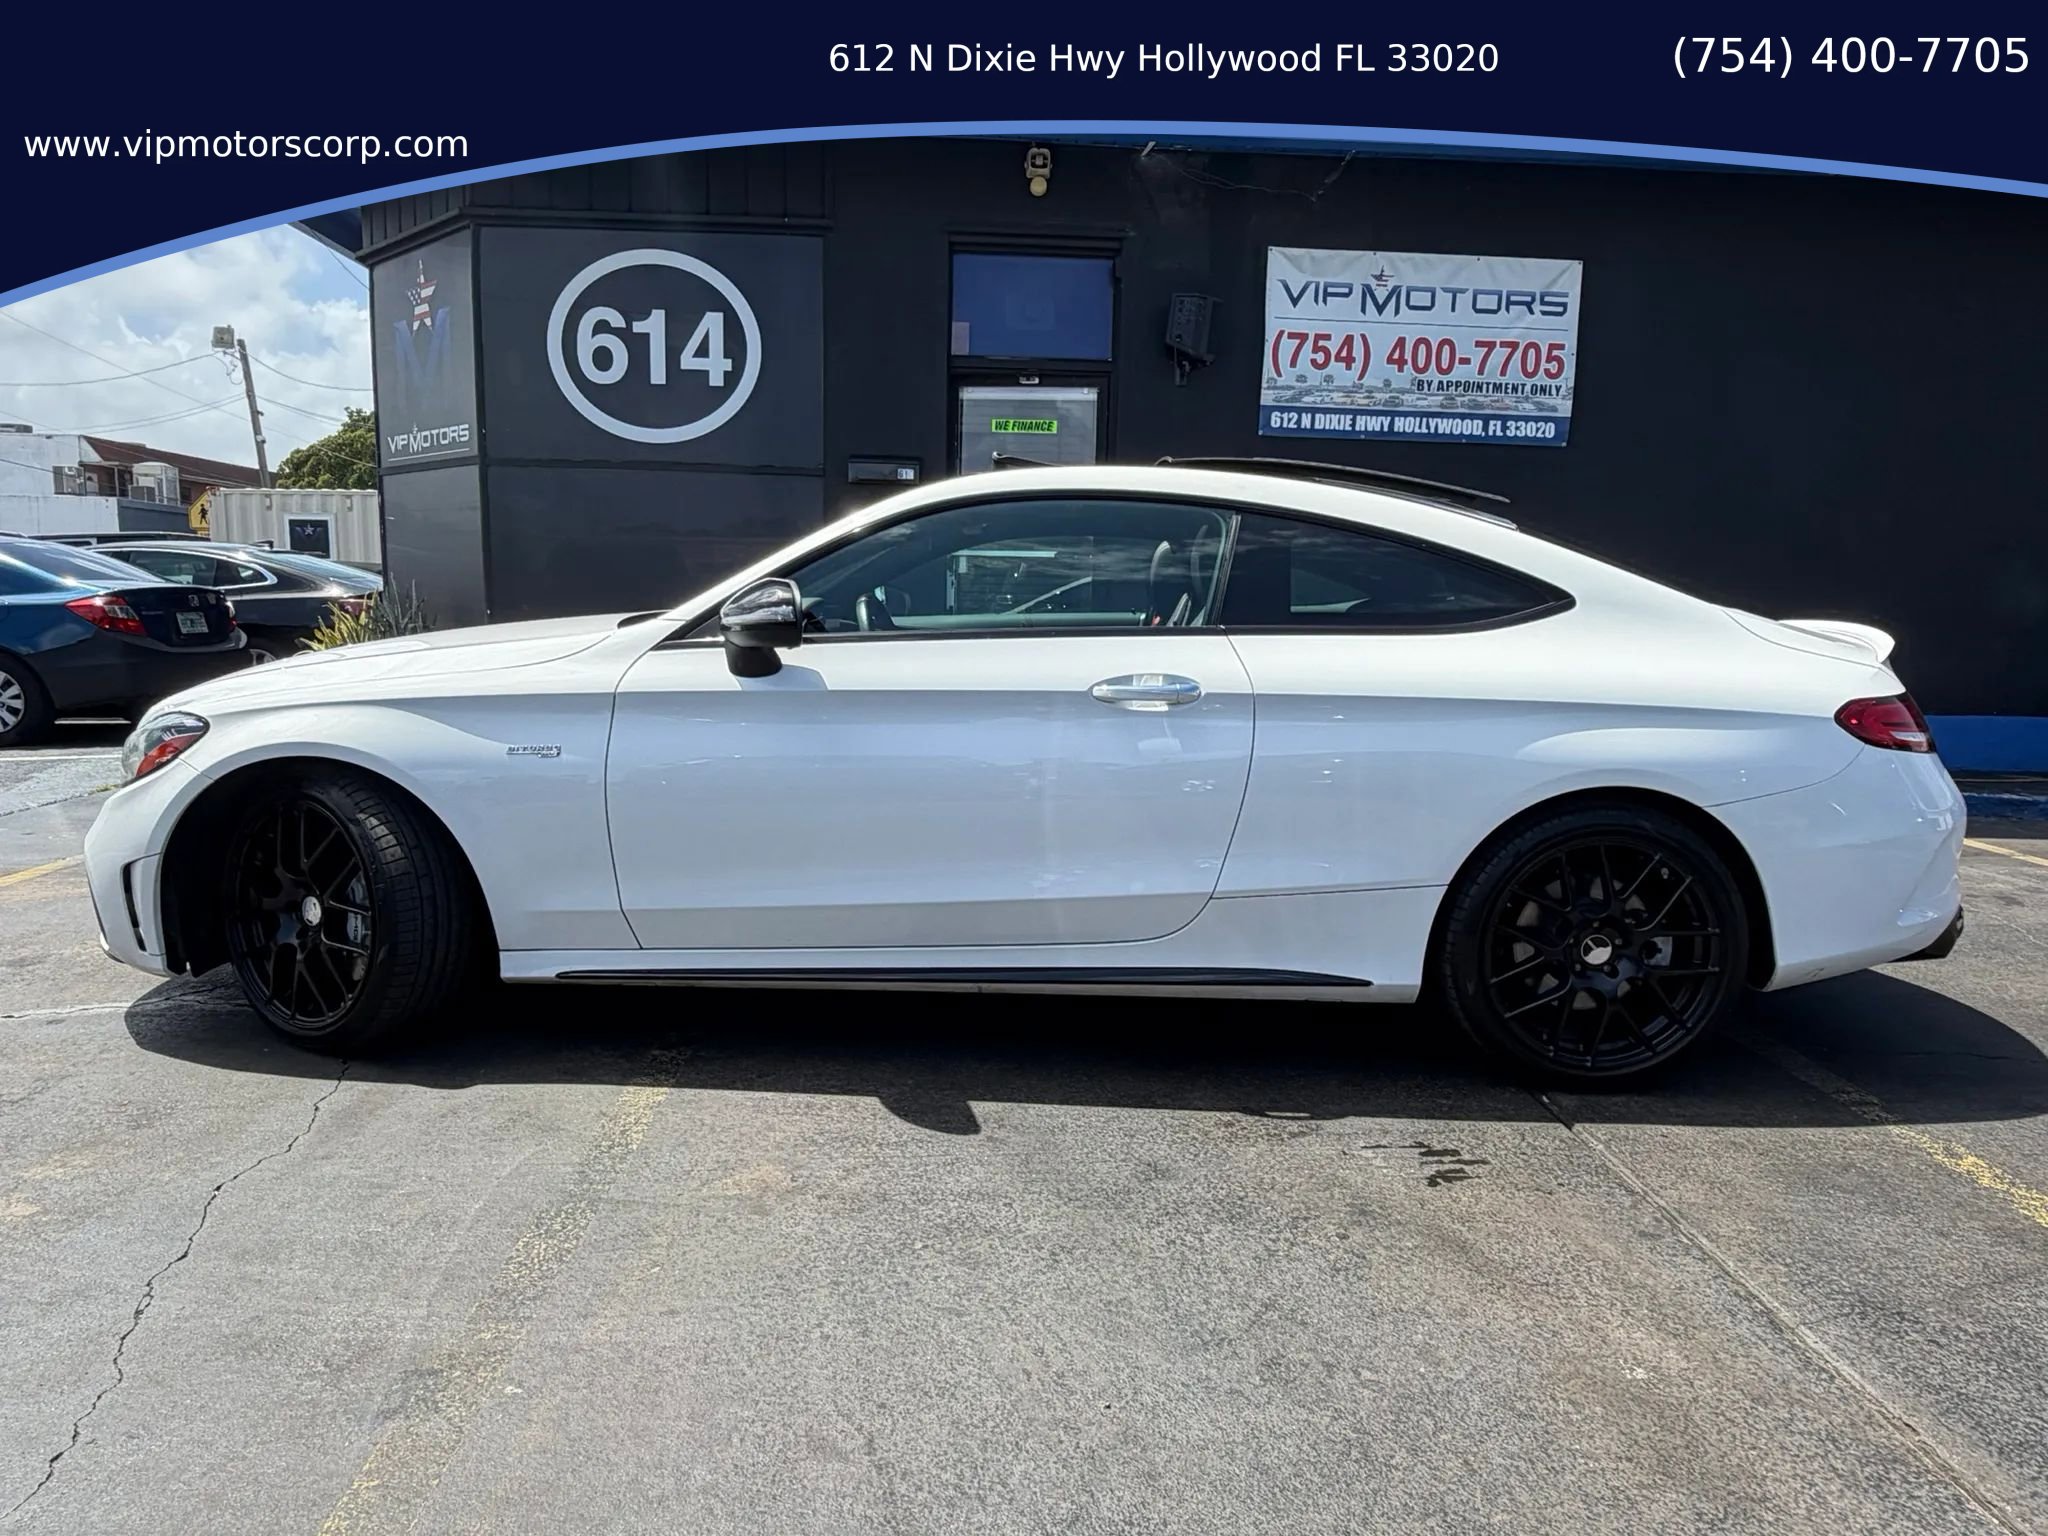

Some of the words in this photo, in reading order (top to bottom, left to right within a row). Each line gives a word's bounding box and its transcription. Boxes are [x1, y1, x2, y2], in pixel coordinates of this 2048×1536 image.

[1277, 279, 1354, 308] VIP
[1360, 283, 1569, 318] MOTORS
[577, 306, 733, 387] 614
[1271, 329, 1371, 381] (754)
[1385, 335, 1566, 380] 400-7705
[1416, 379, 1434, 393] BY
[1436, 380, 1527, 396] APPOINTMENT
[1529, 382, 1563, 397] ONLY
[387, 434, 408, 454] VIP
[409, 424, 470, 453] MOTORS
[995, 420, 1010, 431] WE
[1011, 420, 1054, 432] FINANCE
[1270, 411, 1298, 428] 612
[1300, 412, 1312, 429] N
[1314, 413, 1353, 431] DIXIE
[1355, 415, 1391, 432] HWY
[1393, 416, 1485, 437] HOLLYWOOD,
[1488, 420, 1503, 436] FL
[1506, 420, 1556, 438] 33020
